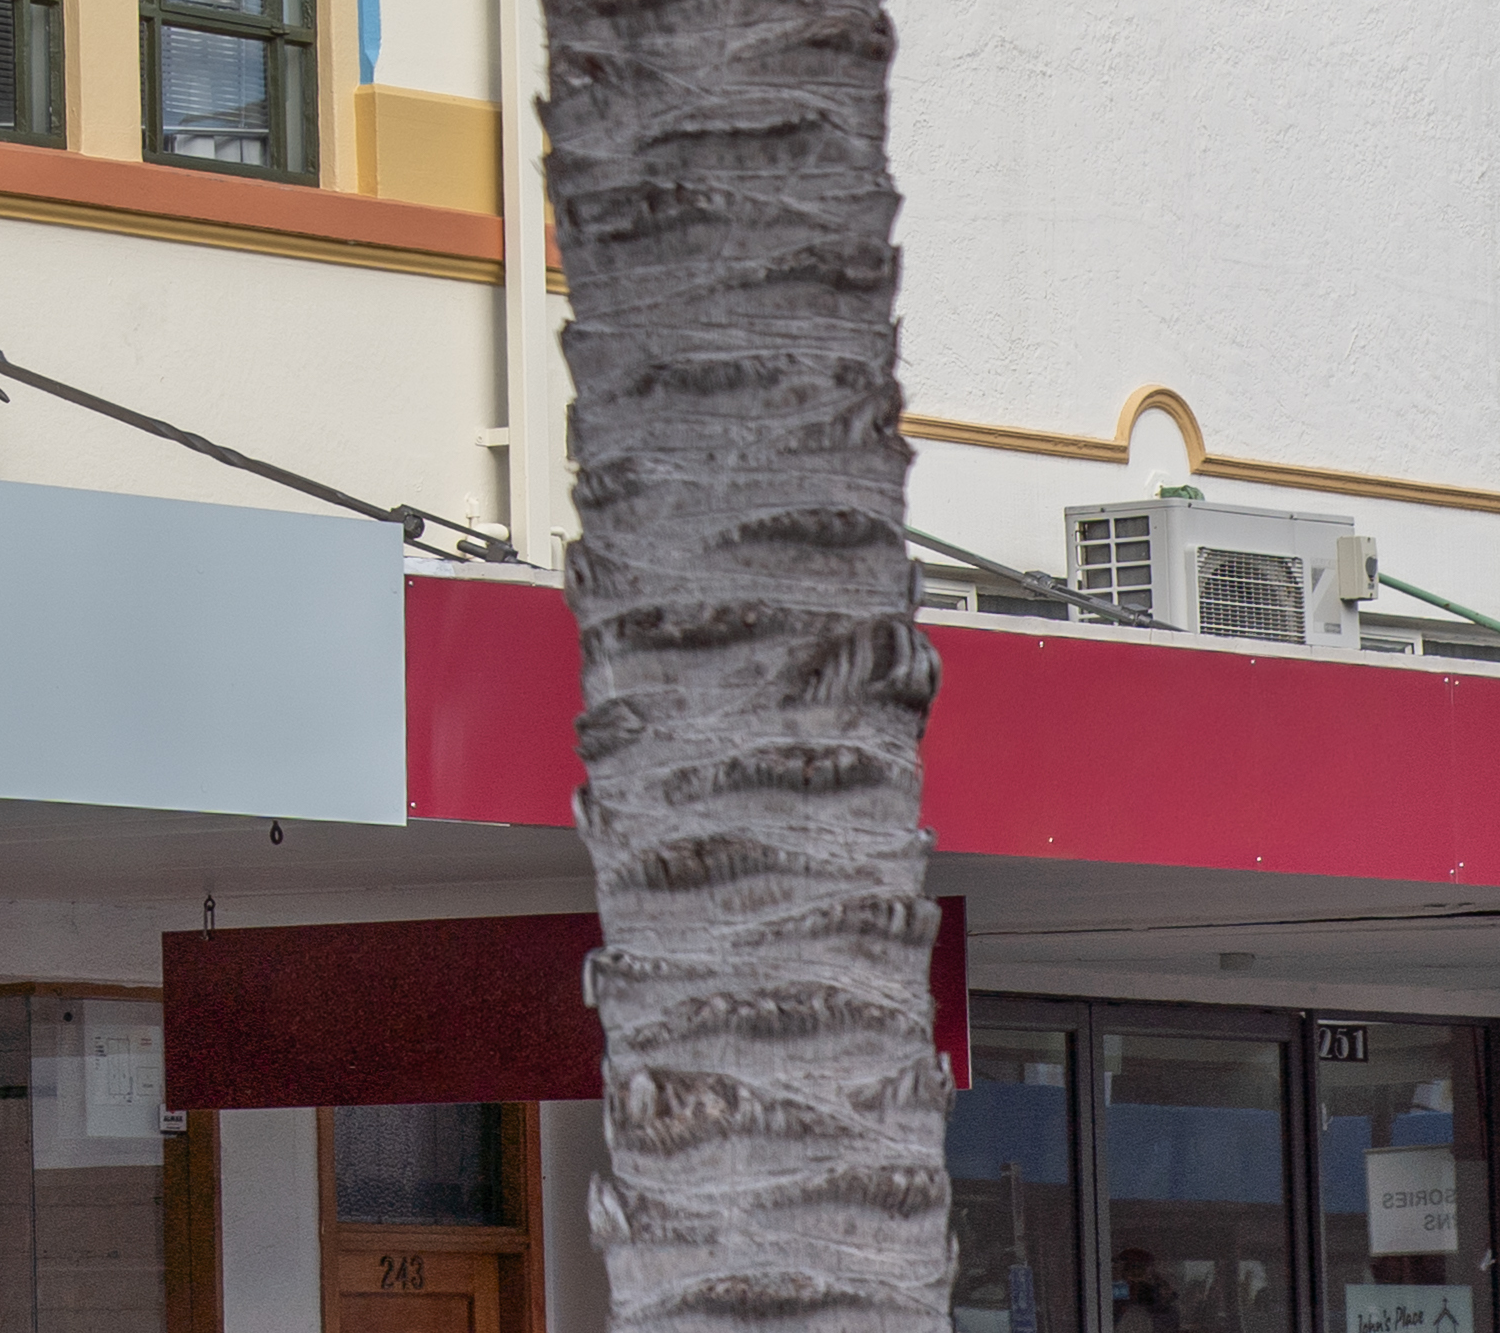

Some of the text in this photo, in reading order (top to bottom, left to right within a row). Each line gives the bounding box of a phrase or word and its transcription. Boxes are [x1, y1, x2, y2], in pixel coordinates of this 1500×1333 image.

[1318, 1026, 1365, 1060] 251
[379, 1255, 425, 1290] 243
[1394, 1305, 1425, 1332] Place
